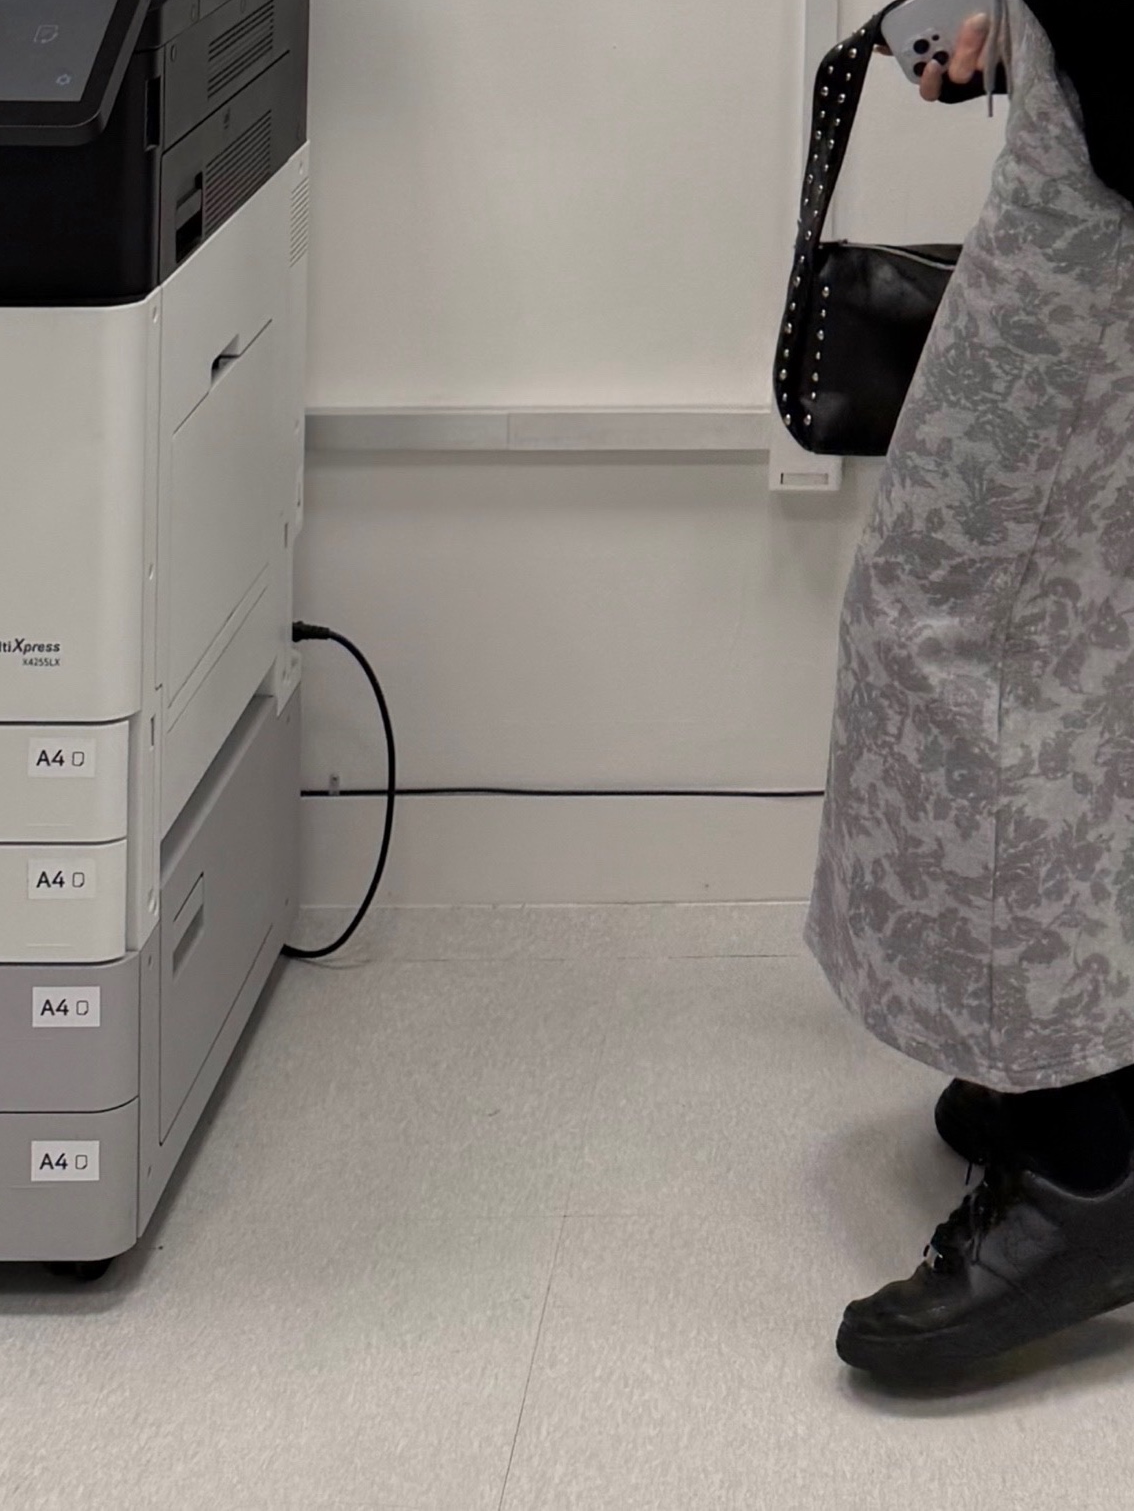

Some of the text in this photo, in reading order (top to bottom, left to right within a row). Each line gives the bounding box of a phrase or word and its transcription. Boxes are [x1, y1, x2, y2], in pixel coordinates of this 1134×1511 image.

[36, 749, 65, 767] A4
[36, 870, 65, 888] A4
[40, 998, 70, 1016] A4
[39, 1153, 69, 1171] A4
